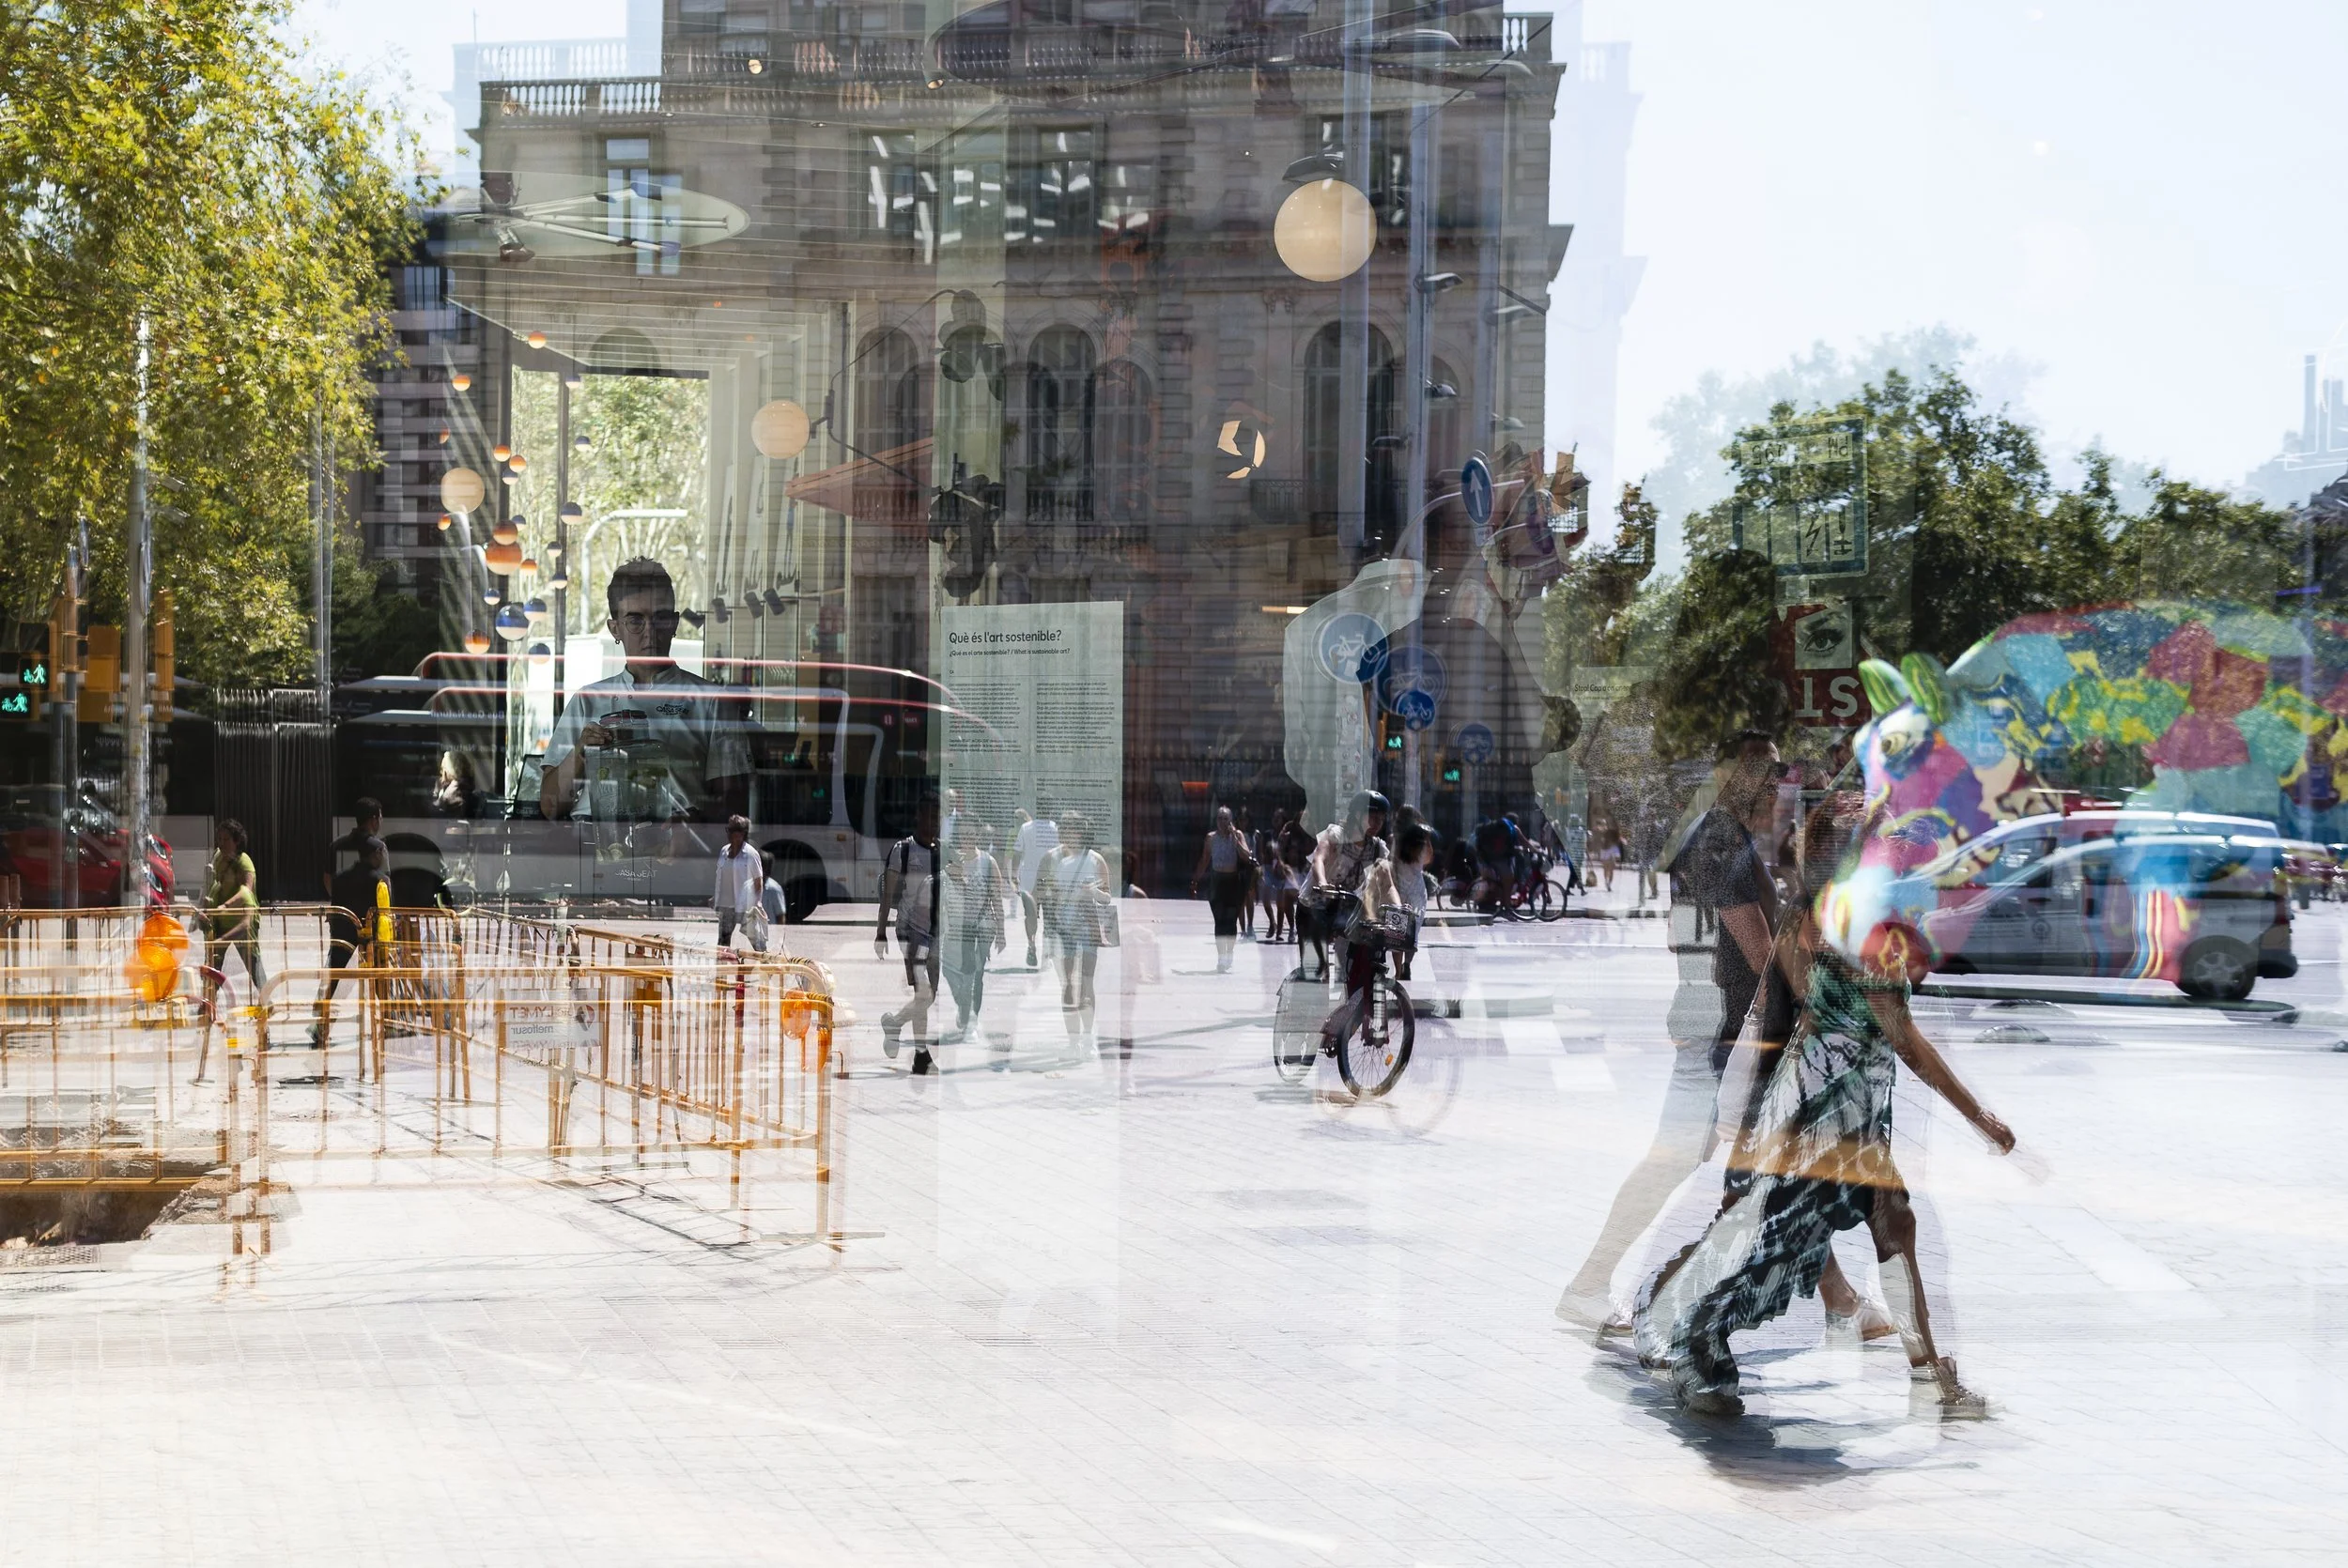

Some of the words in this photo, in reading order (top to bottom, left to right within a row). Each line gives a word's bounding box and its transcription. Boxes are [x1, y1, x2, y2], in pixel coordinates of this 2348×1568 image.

[949, 632, 969, 645] Què
[971, 631, 982, 643] és
[984, 631, 1004, 643] l'art
[1005, 629, 1062, 642] sostenible?
